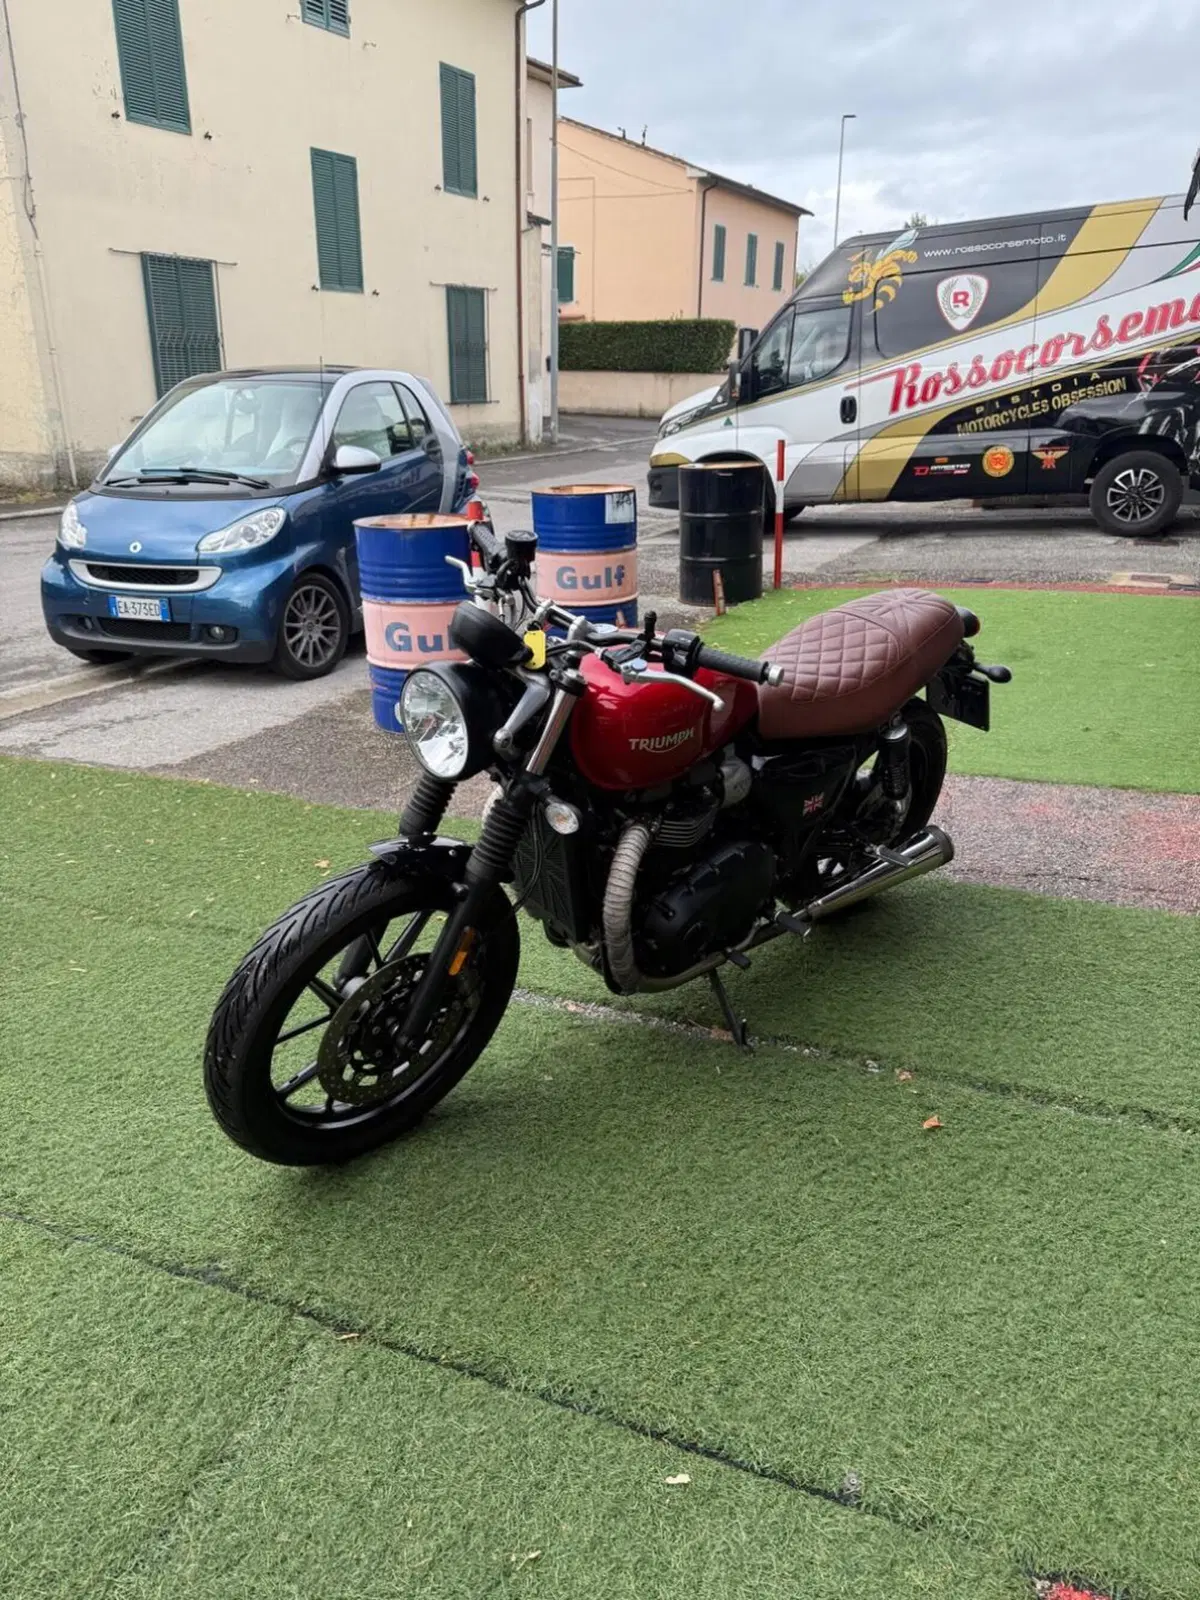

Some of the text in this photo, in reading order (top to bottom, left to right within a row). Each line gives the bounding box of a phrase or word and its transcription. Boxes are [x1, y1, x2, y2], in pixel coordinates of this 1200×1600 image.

[924, 233, 1067, 257] www.rossocorsemoto.it
[957, 377, 1127, 437] MOTORCYCLES OBSESSION
[976, 372, 1101, 414] PISTOIA
[556, 565, 625, 589] Gulf
[385, 621, 460, 652] Gul
[628, 727, 694, 752] TRIUMPH
